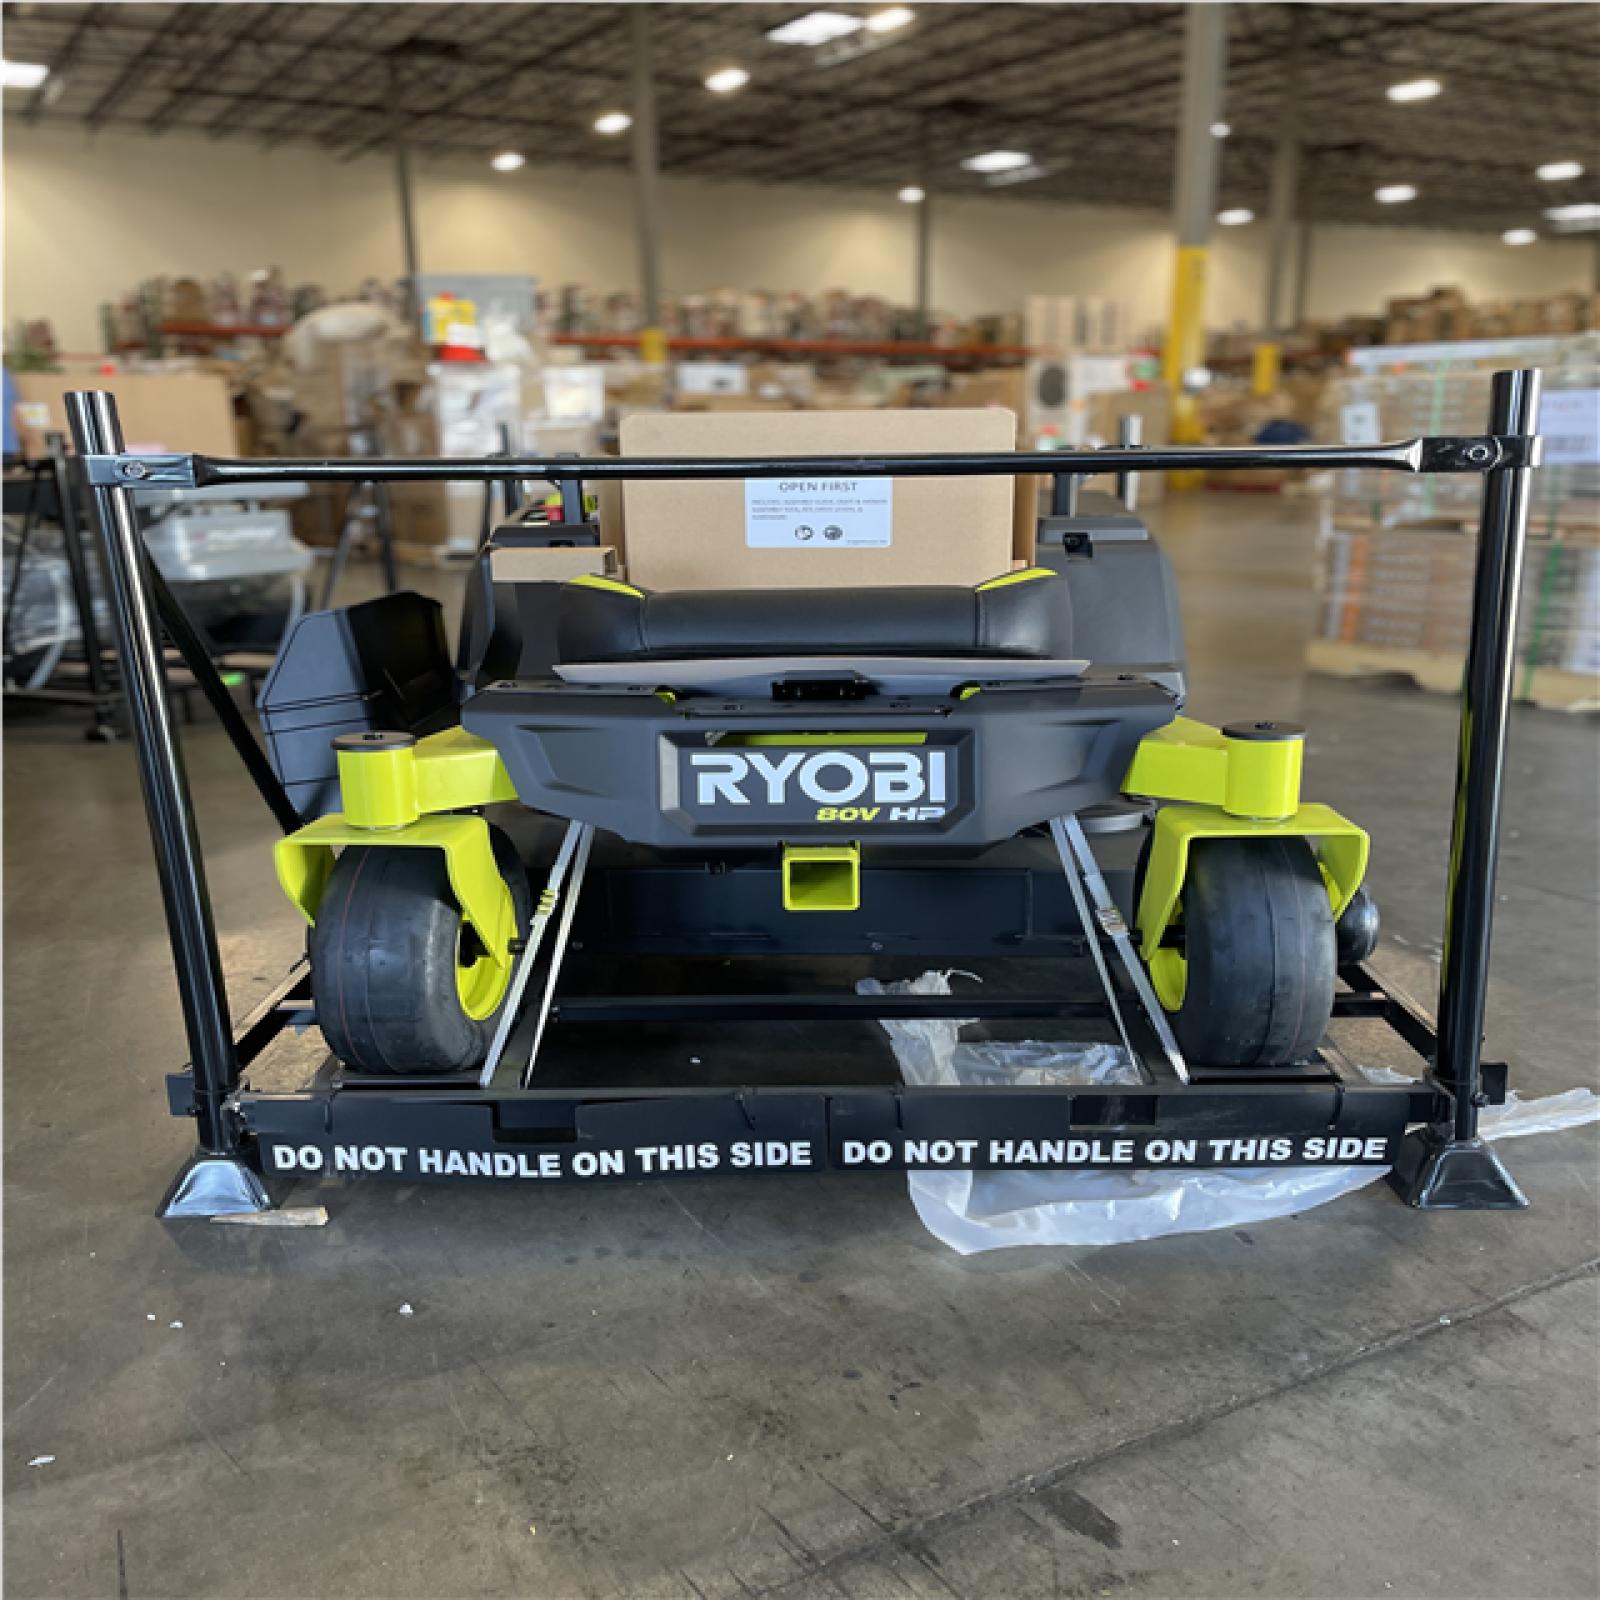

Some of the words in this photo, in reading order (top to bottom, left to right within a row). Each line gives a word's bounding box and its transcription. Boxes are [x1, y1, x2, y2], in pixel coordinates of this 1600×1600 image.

[779, 481, 817, 493] OPEN
[821, 481, 858, 493] FIRST
[690, 750, 946, 805] RYOBI
[815, 807, 881, 822] 80V
[889, 807, 946, 821] HP
[272, 1144, 322, 1170] DO
[334, 1145, 408, 1172] NOT
[419, 1148, 562, 1178] HANDLE
[572, 1149, 625, 1176] ON
[635, 1143, 720, 1171] THIS
[730, 1141, 813, 1167] SIDE
[843, 1140, 893, 1164] DO
[904, 1139, 978, 1164] NOT
[989, 1139, 1134, 1164] HANDLE
[1144, 1139, 1197, 1164] ON
[1208, 1137, 1292, 1162] THIS
[1302, 1136, 1389, 1161] SIDE
